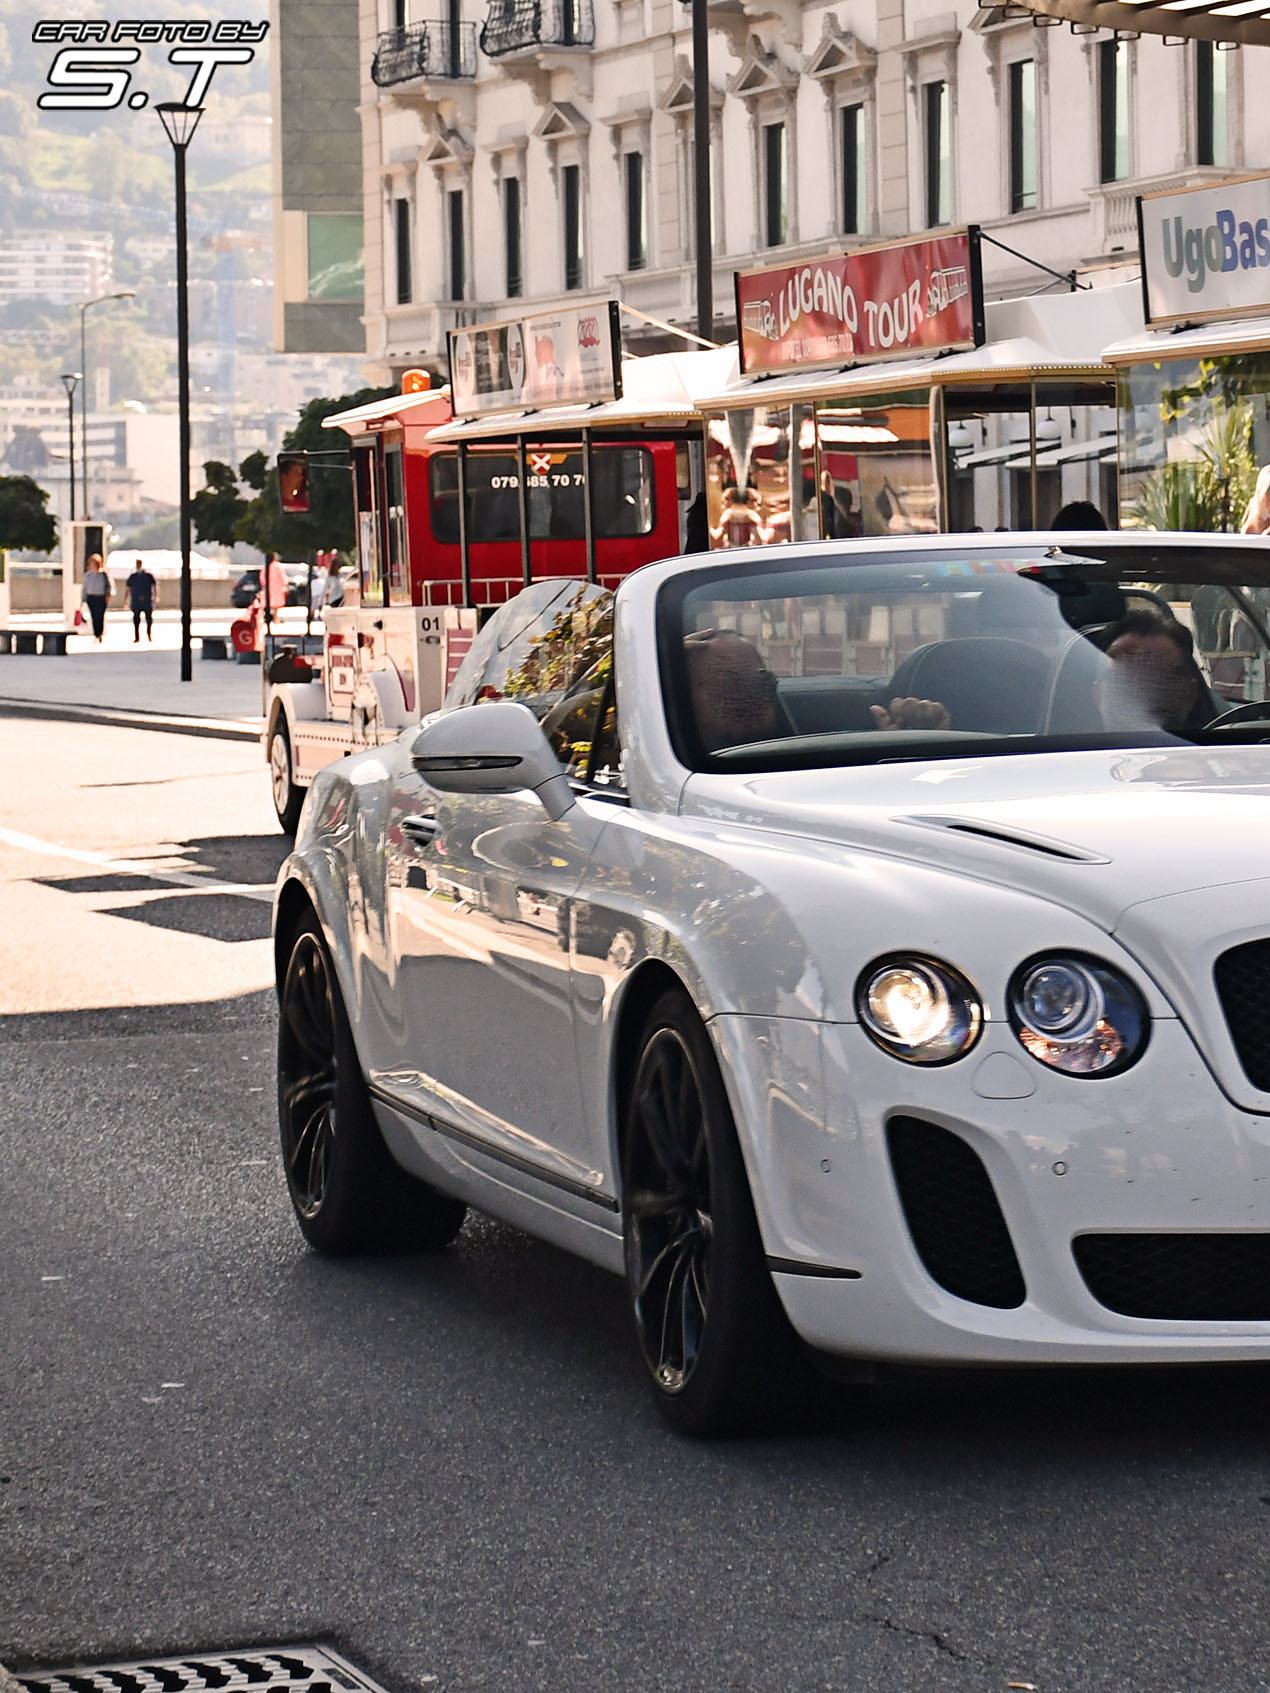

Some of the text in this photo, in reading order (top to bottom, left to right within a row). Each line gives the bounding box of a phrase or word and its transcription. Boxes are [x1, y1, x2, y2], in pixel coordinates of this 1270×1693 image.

[779, 267, 923, 348] LUGANO TOUR
[491, 475, 519, 489] 079
[551, 474, 570, 488] 70
[421, 616, 440, 632] 01
